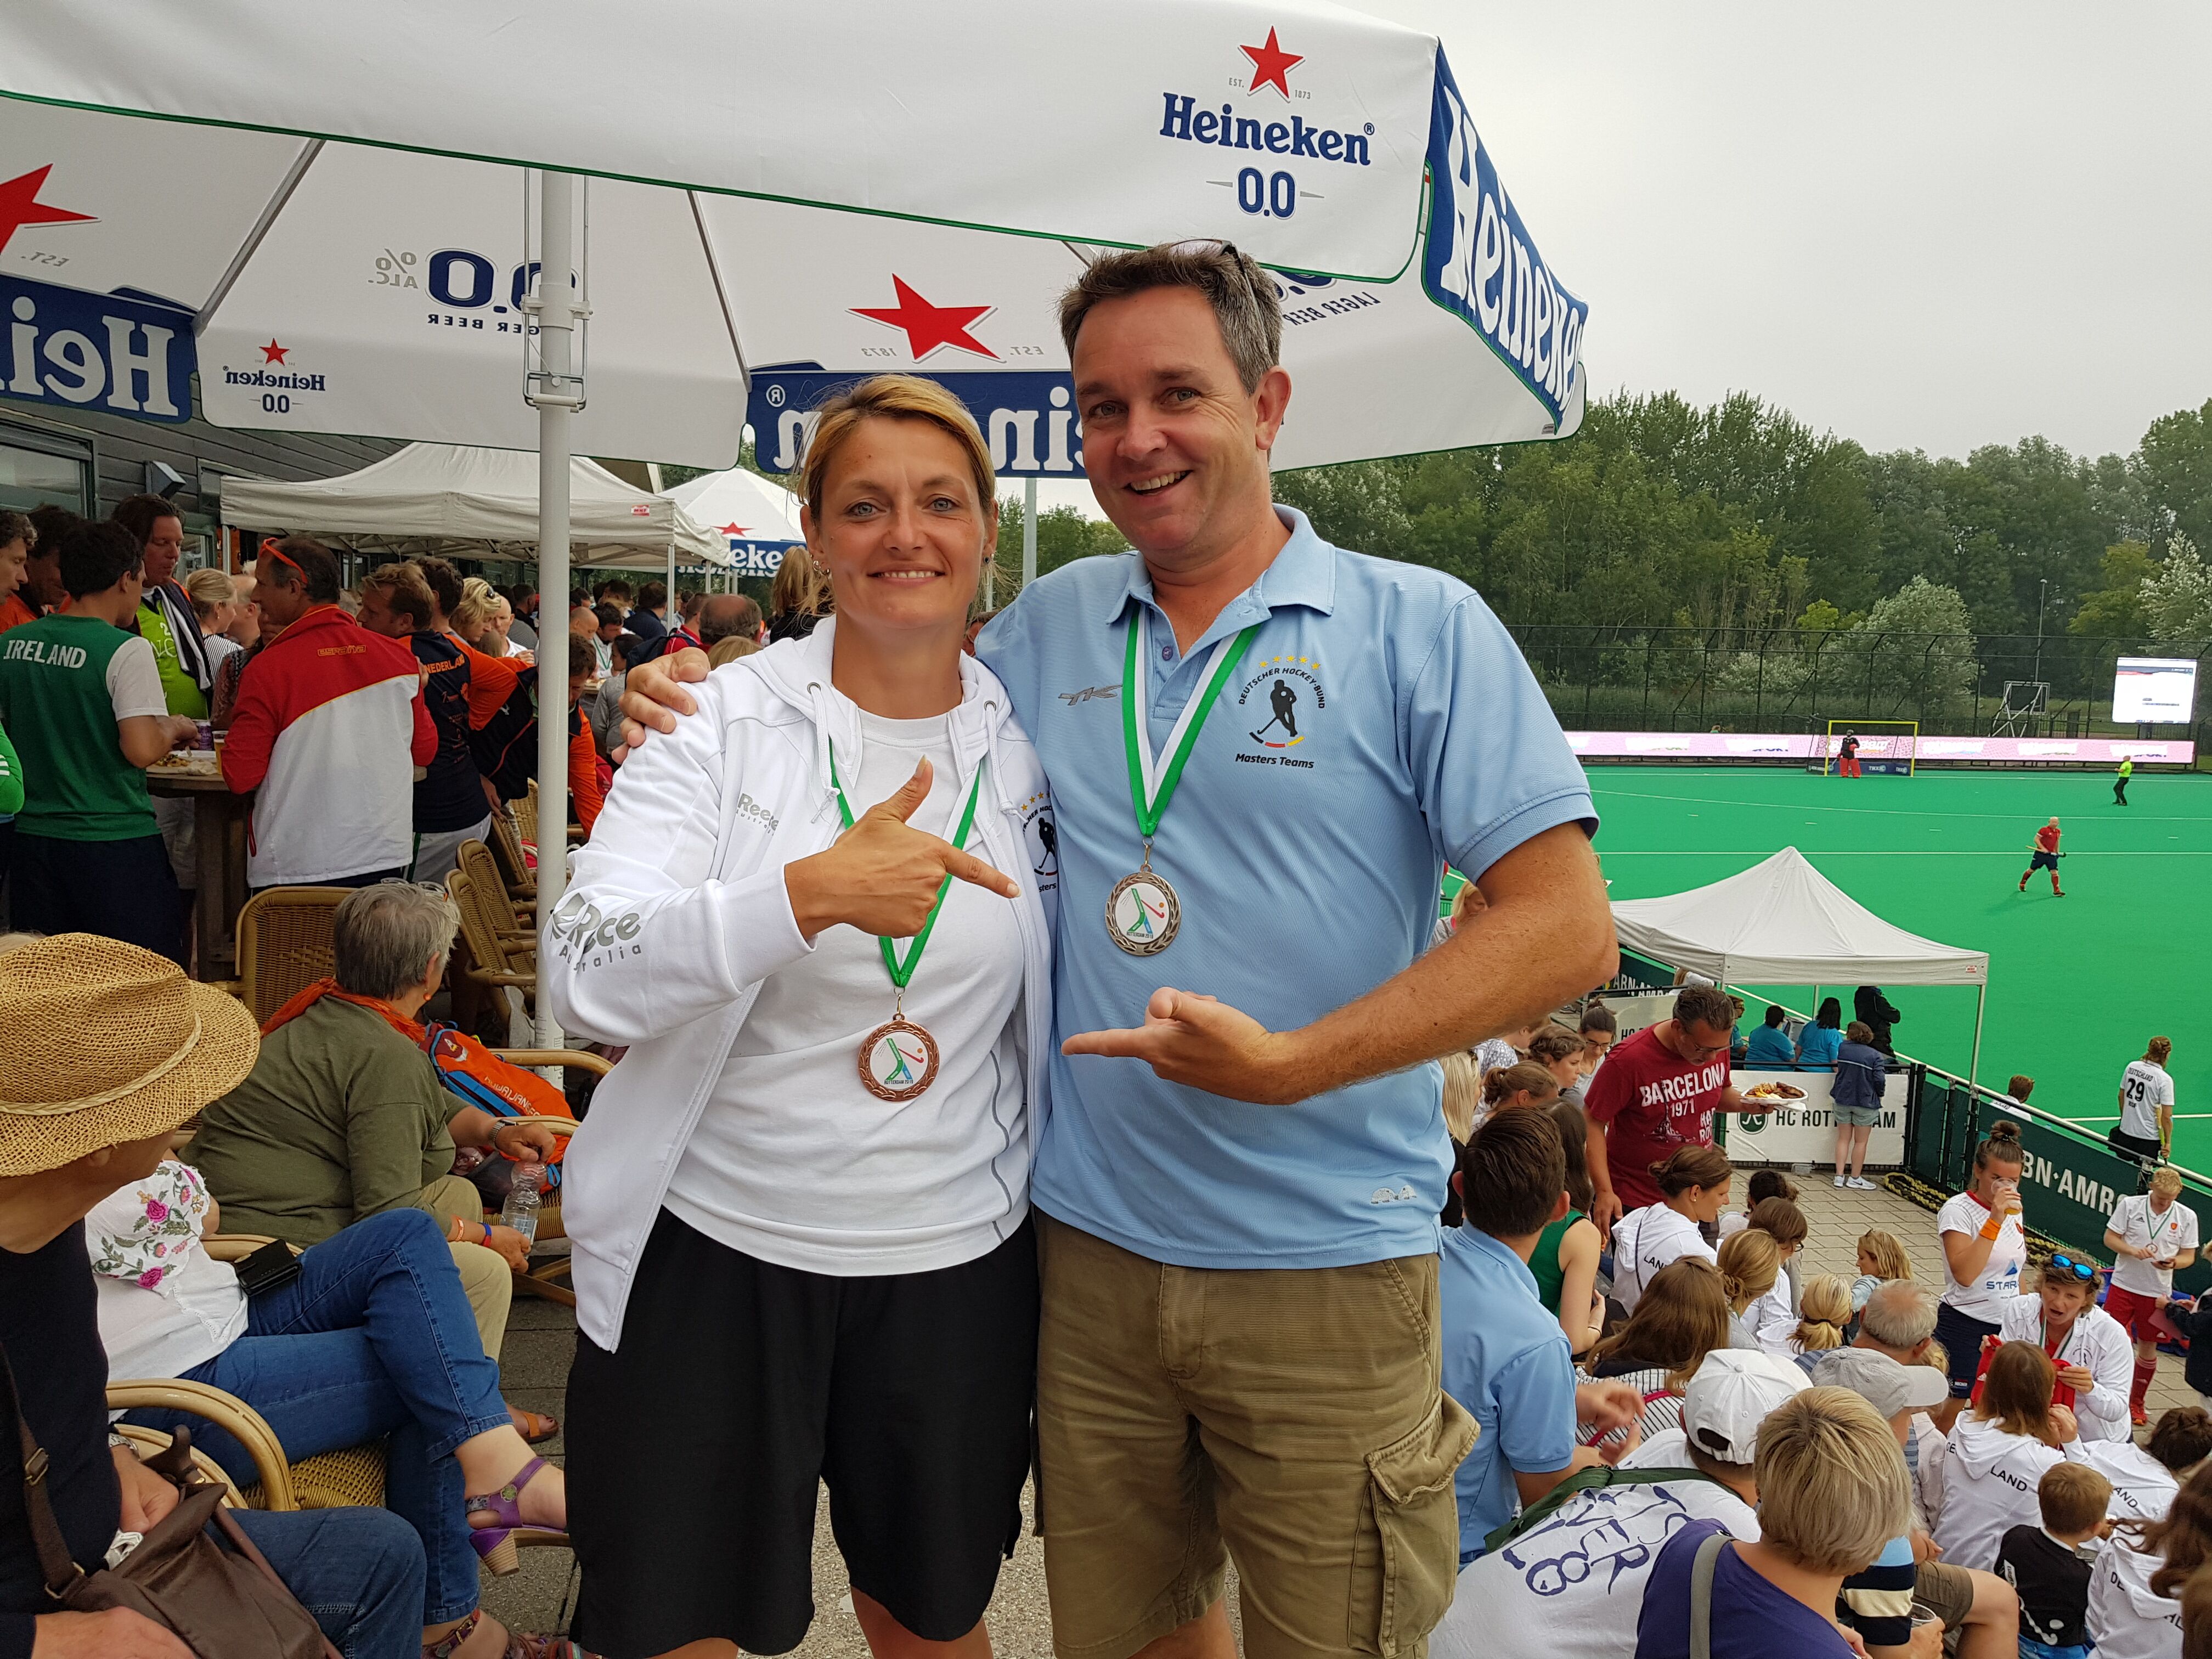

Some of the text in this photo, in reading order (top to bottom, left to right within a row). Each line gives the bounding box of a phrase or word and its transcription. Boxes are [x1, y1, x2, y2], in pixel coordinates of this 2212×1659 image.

[1228, 77, 1312, 100] EST. 1873
[1237, 167, 1296, 218] 0.0
[3, 640, 87, 669] IRELAND
[1239, 668, 1325, 709] DEUTSCHER HOCKEY-BUND
[1235, 753, 1314, 769] Masters Teams
[1039, 883, 1057, 893] sters
[1639, 1062, 1725, 1107] BARCELONA
[2126, 1077, 2145, 1102] 29
[1670, 1098, 1695, 1118] 1971
[1776, 1109, 1796, 1126] HC
[1644, 1255, 1664, 1269] LAN
[1990, 1464, 2028, 1492] LAND
[2112, 1487, 2138, 1508] AND
